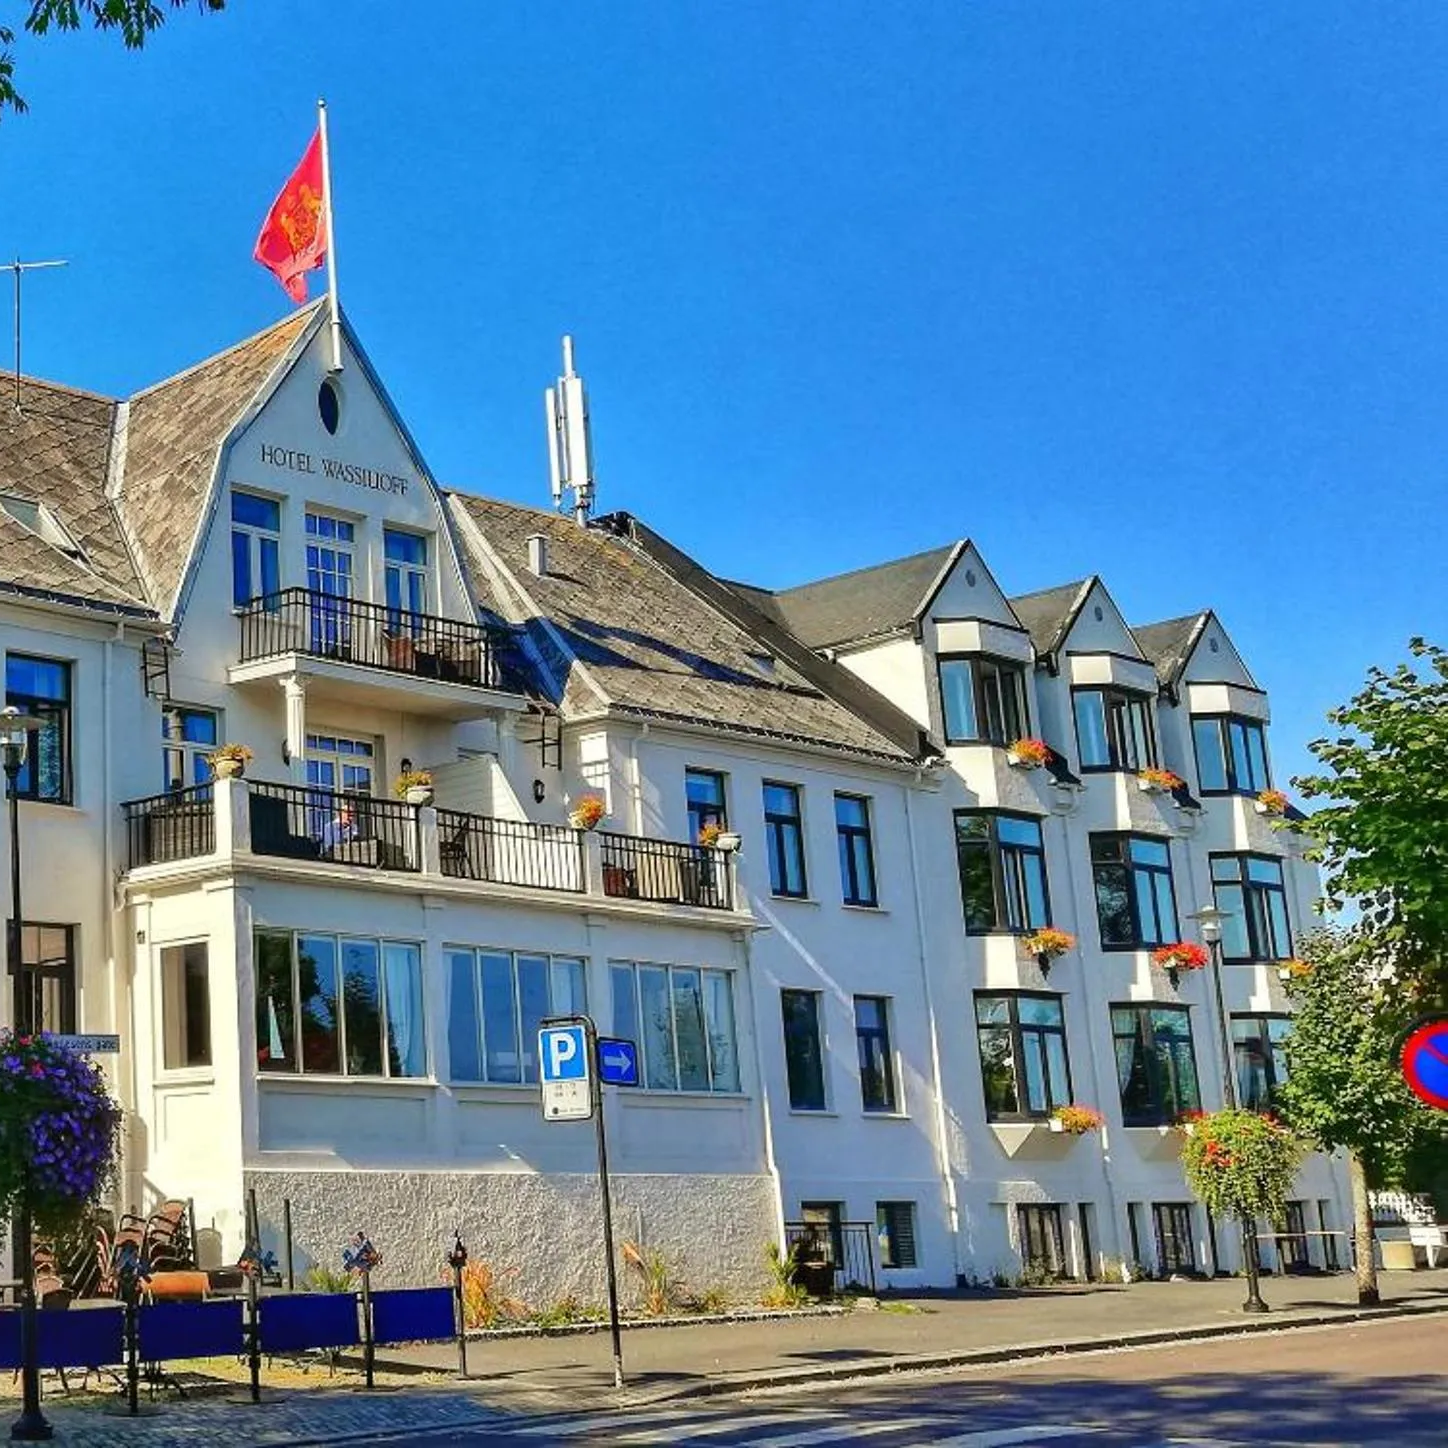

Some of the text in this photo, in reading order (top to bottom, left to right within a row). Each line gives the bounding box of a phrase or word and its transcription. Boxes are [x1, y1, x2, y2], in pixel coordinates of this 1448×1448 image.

[261, 443, 409, 496] HOTEL WASSILIOFF
[550, 1032, 576, 1077] P
